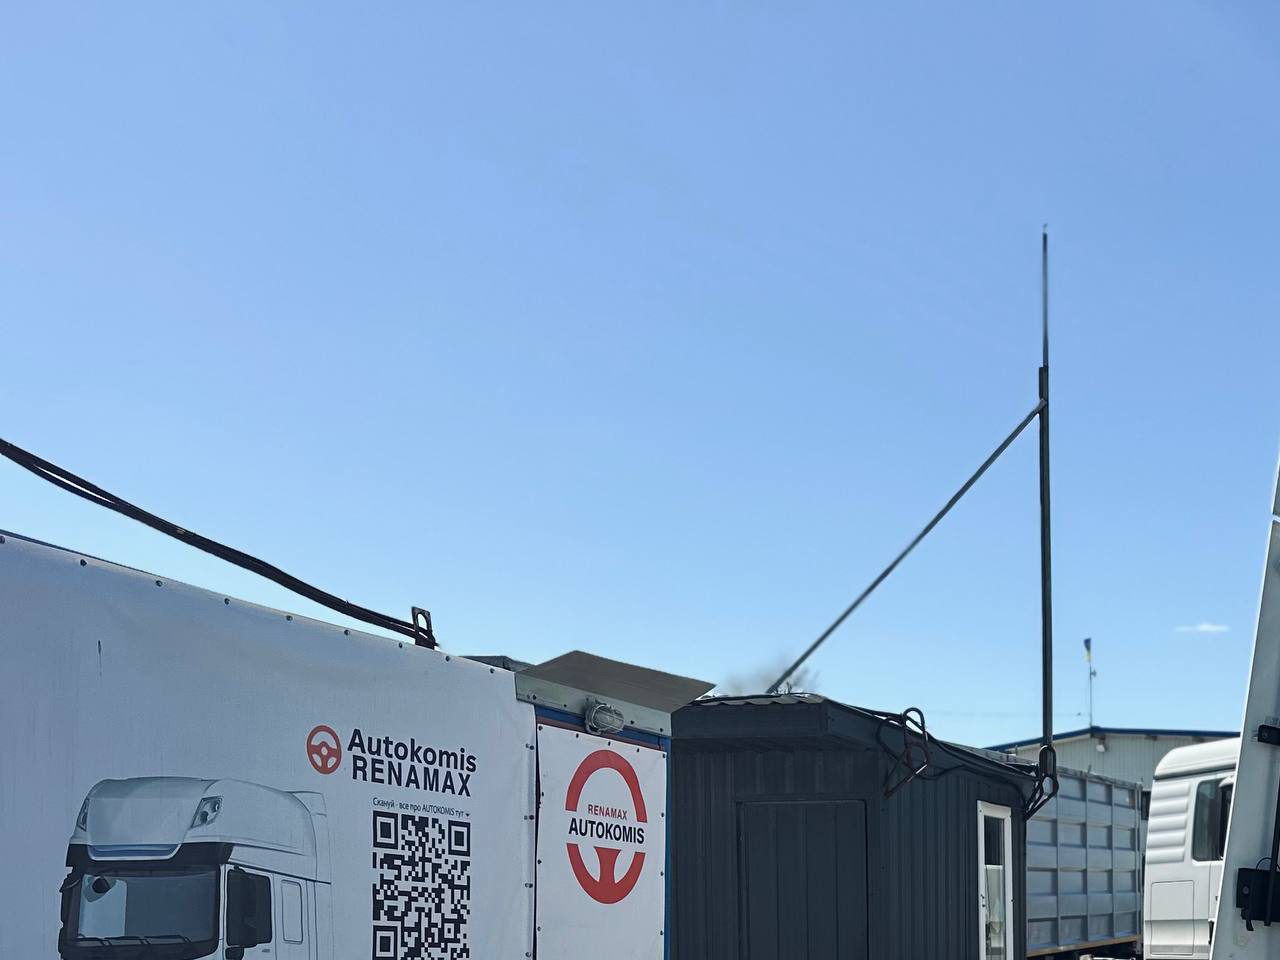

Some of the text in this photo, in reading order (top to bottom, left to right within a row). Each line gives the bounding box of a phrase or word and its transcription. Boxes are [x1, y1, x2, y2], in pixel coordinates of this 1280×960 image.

[347, 728, 477, 773] Autokomis
[352, 754, 471, 797] RENAMAX
[372, 797, 395, 809] Скануй
[399, 802, 409, 810] все
[410, 803, 421, 813] про
[422, 804, 455, 816] AUTOKOMIS
[587, 804, 628, 820] RENAMAX
[568, 817, 645, 844] AUTOKOMIS
